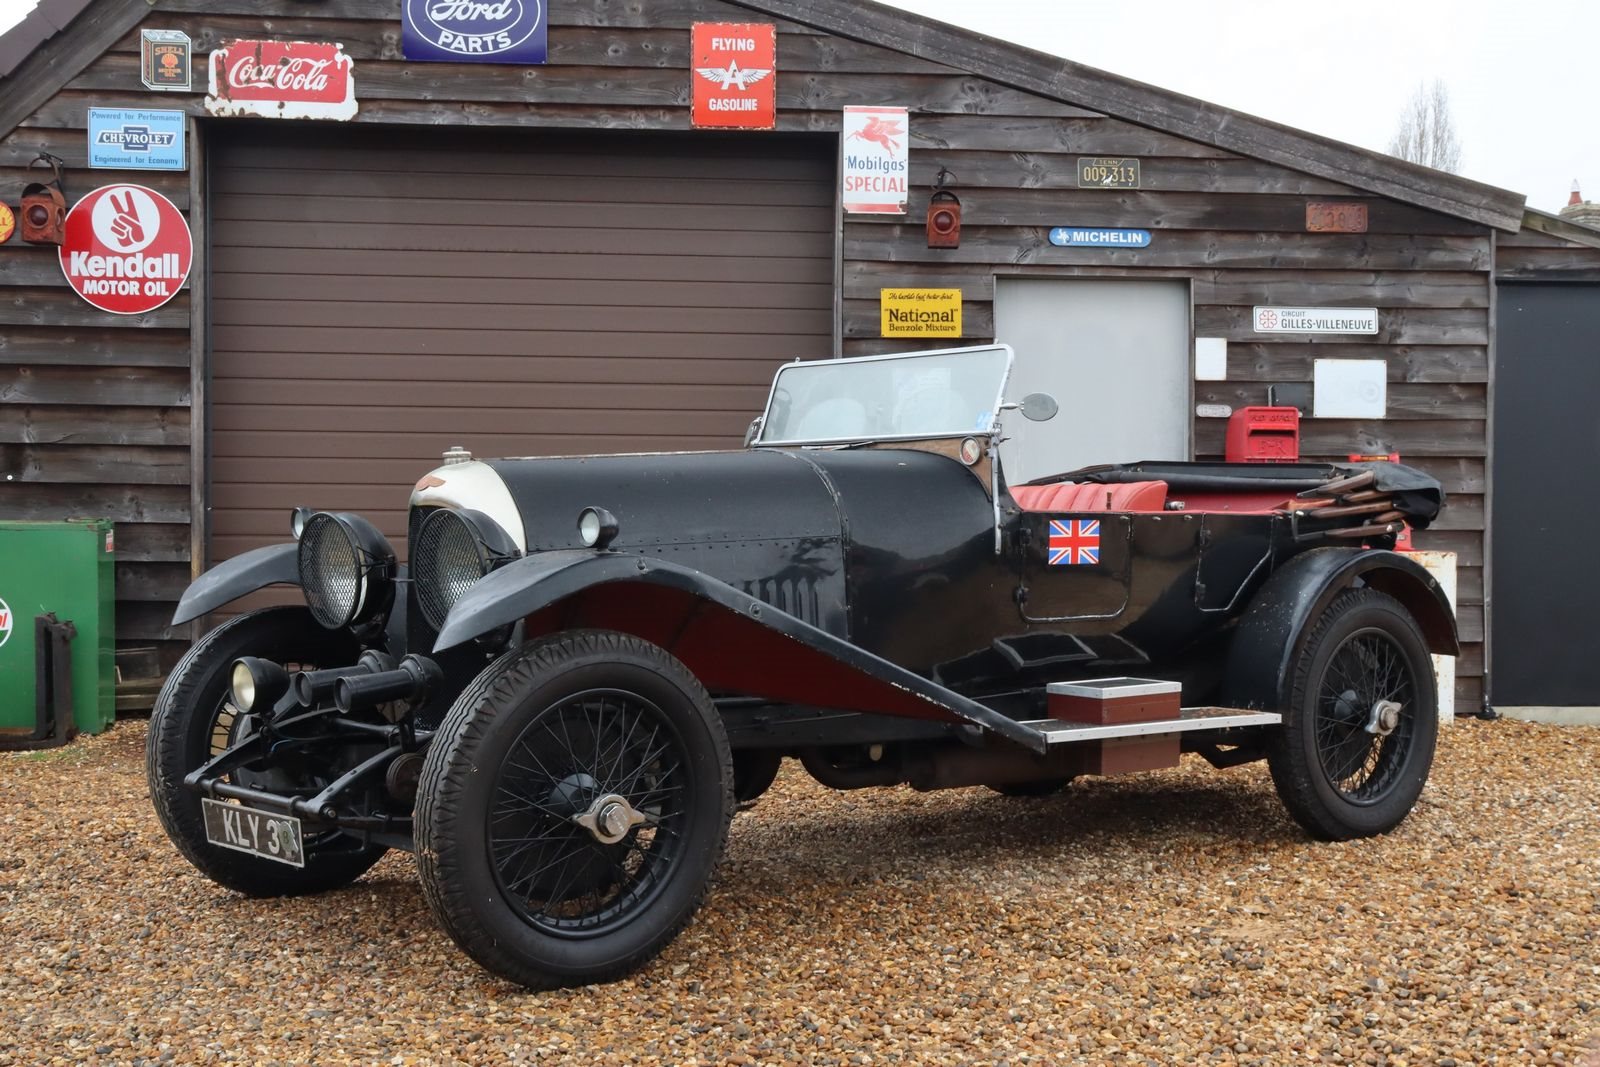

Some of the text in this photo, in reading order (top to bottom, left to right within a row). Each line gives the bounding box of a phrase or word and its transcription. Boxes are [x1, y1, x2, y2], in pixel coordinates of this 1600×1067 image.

[431, 0, 513, 21] Ford
[438, 30, 512, 52] PARTS
[711, 37, 755, 51] FLYING
[154, 46, 184, 55] SHELL
[229, 56, 333, 91] Coca-Cola
[708, 98, 758, 111] GASOLINE
[91, 111, 181, 122] Powered for Performance
[102, 133, 170, 145] CHEVROLET
[94, 155, 178, 166] Engineered for Economy
[847, 155, 905, 174] Mobilgas
[845, 175, 907, 193] SPECIAL
[1072, 231, 1142, 243] MICHELIN
[70, 251, 180, 279] Kendall
[82, 280, 170, 297] MOTOR OIL
[888, 323, 957, 332] Benzole Mixture
[222, 808, 259, 849] KLY
